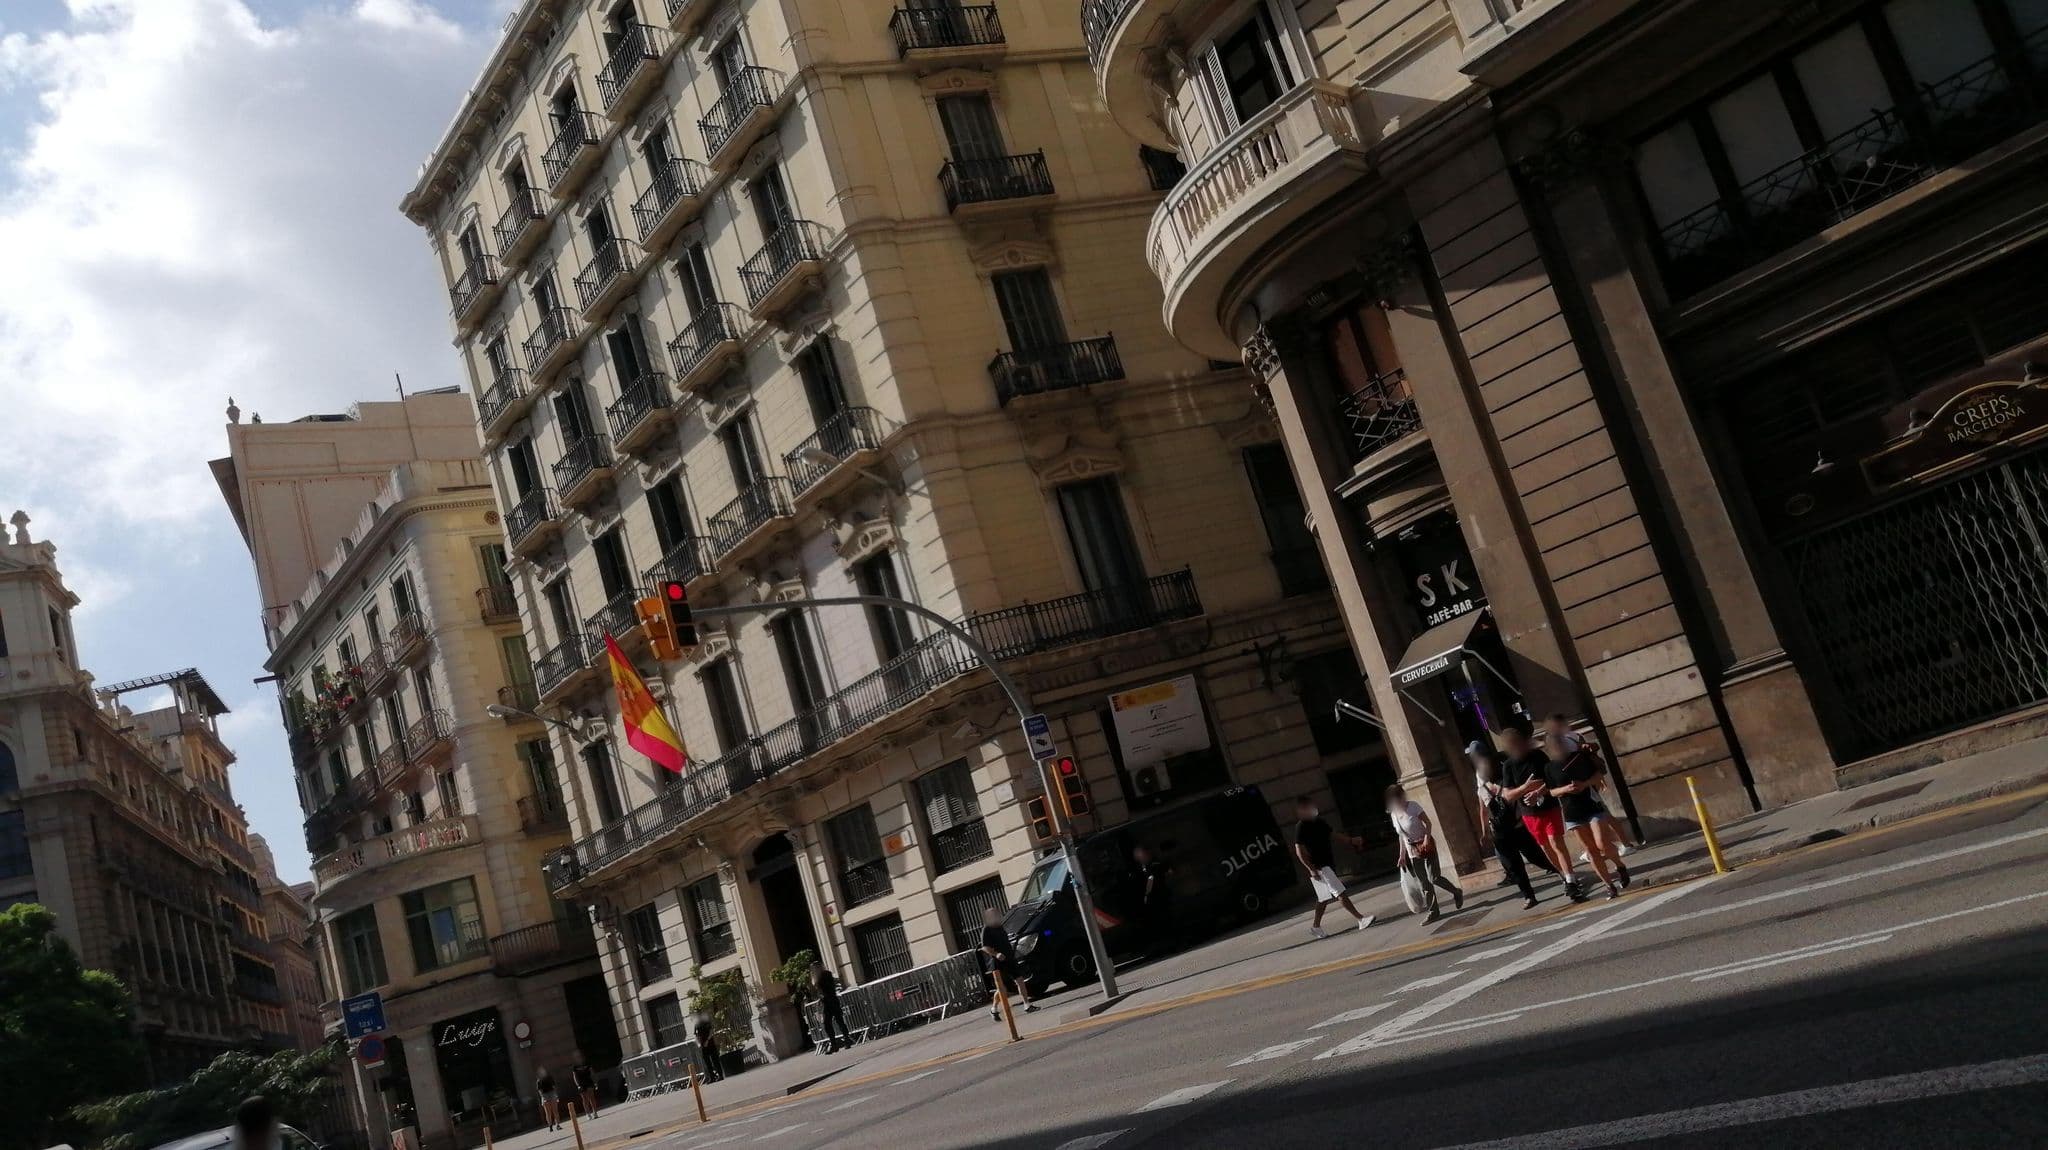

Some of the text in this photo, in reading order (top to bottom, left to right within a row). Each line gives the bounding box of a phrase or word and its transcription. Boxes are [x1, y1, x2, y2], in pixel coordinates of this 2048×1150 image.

[1947, 406, 2026, 444] BARCELONA
[1953, 394, 2010, 427] CREPS
[438, 1018, 496, 1047] Luigi
